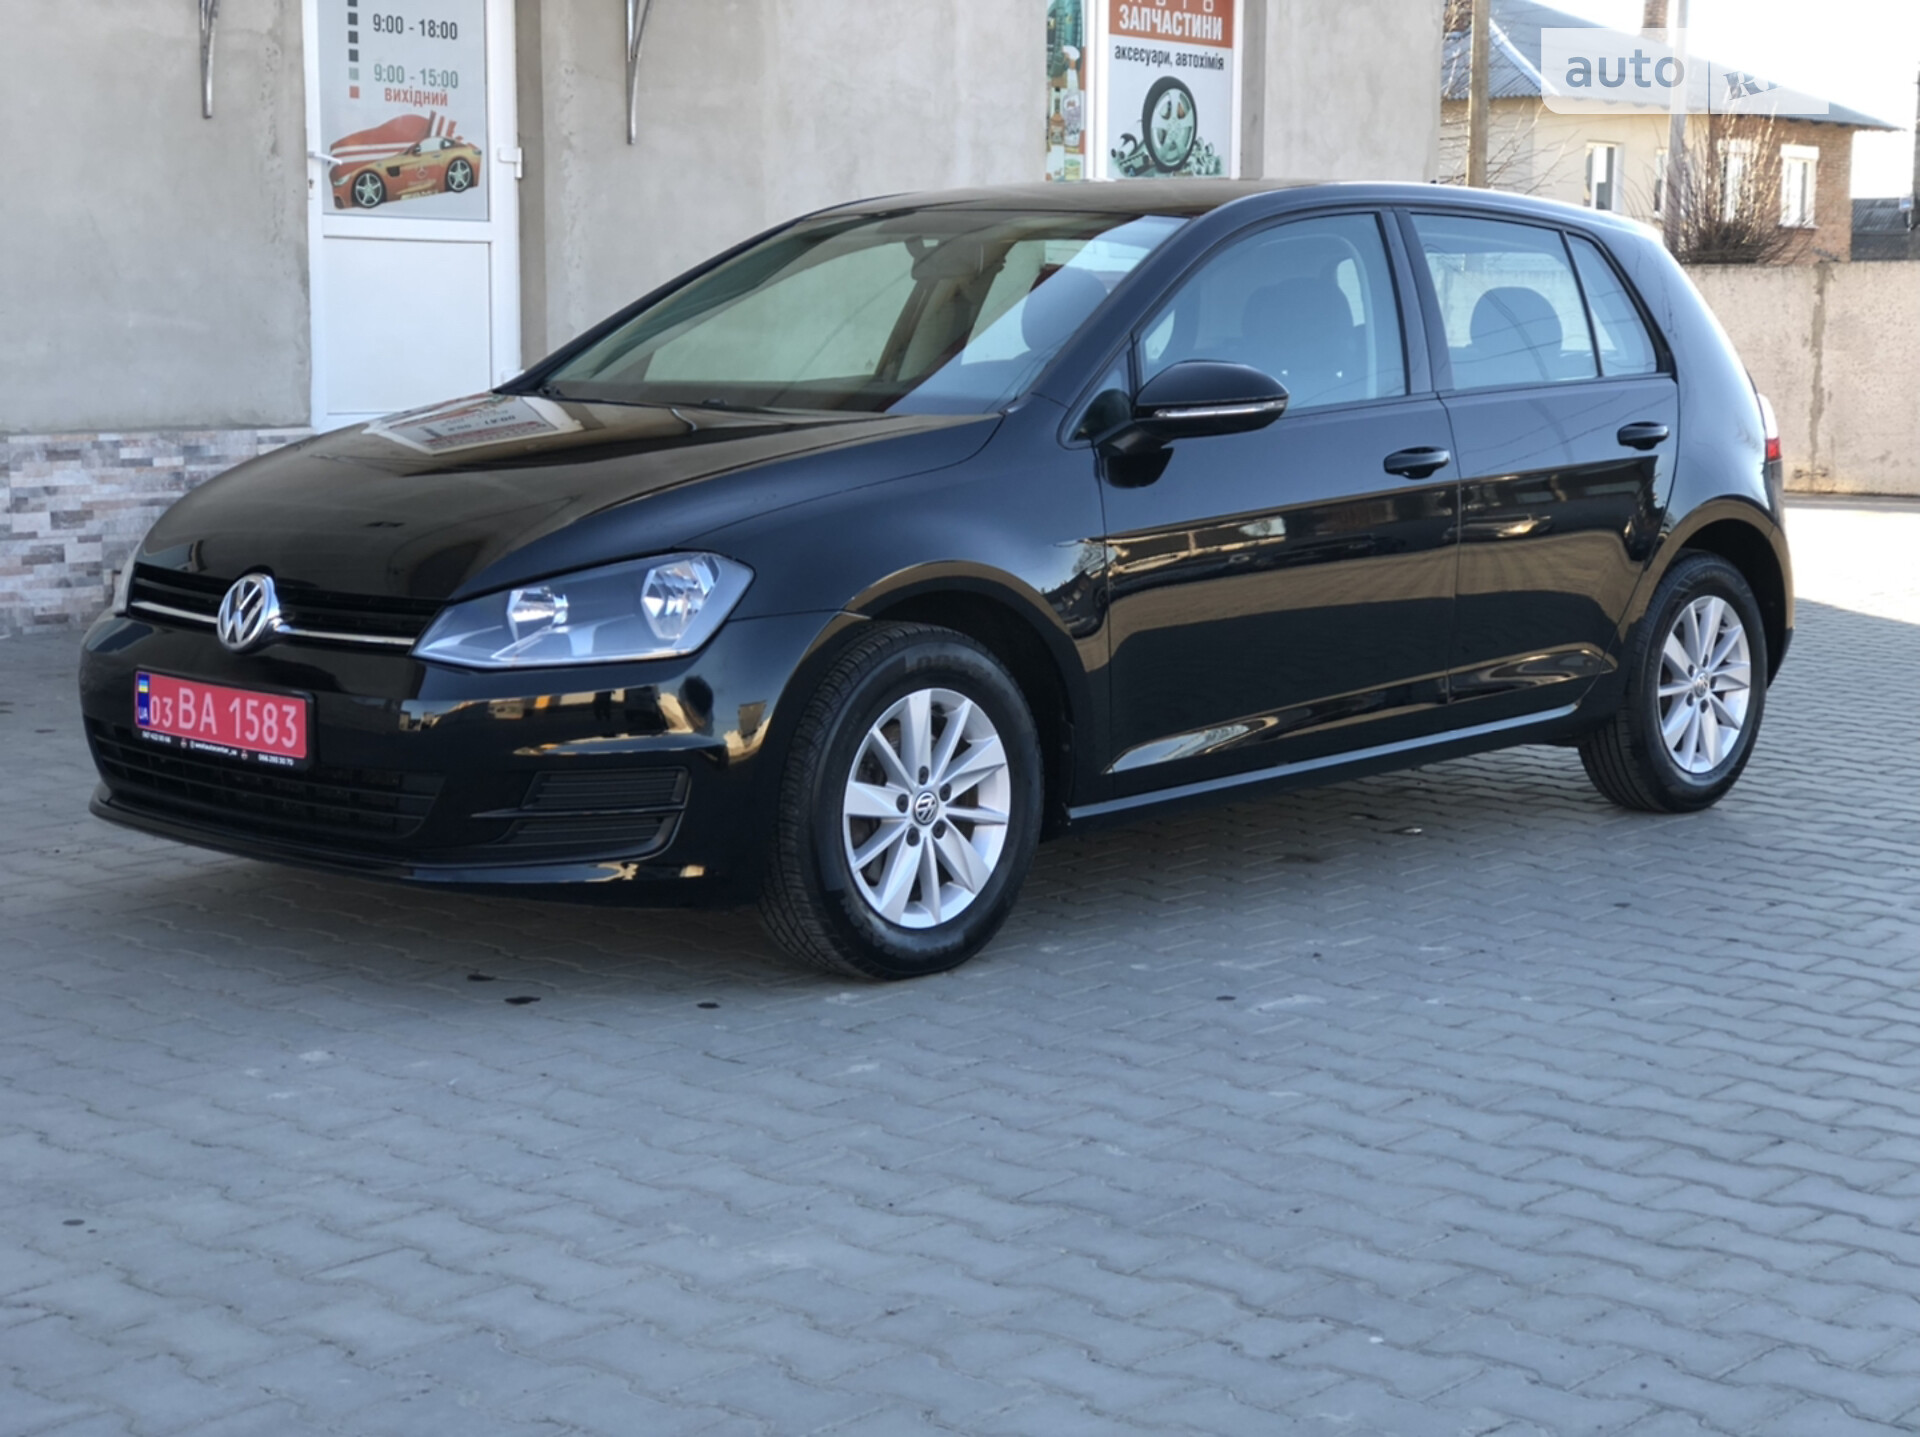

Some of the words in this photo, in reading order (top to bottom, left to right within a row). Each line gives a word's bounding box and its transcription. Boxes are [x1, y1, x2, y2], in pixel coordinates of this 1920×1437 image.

[373, 13, 404, 34] 9:00
[418, 19, 458, 40] 18:00
[1119, 4, 1223, 41] ЗАПЧАСТИНИ
[1114, 45, 1173, 68] аксесуари,
[1175, 51, 1225, 70] автохімія
[374, 63, 405, 84] 9:00
[419, 68, 459, 89] 15:00
[384, 86, 448, 107] вихідний
[229, 697, 298, 748] 1583
